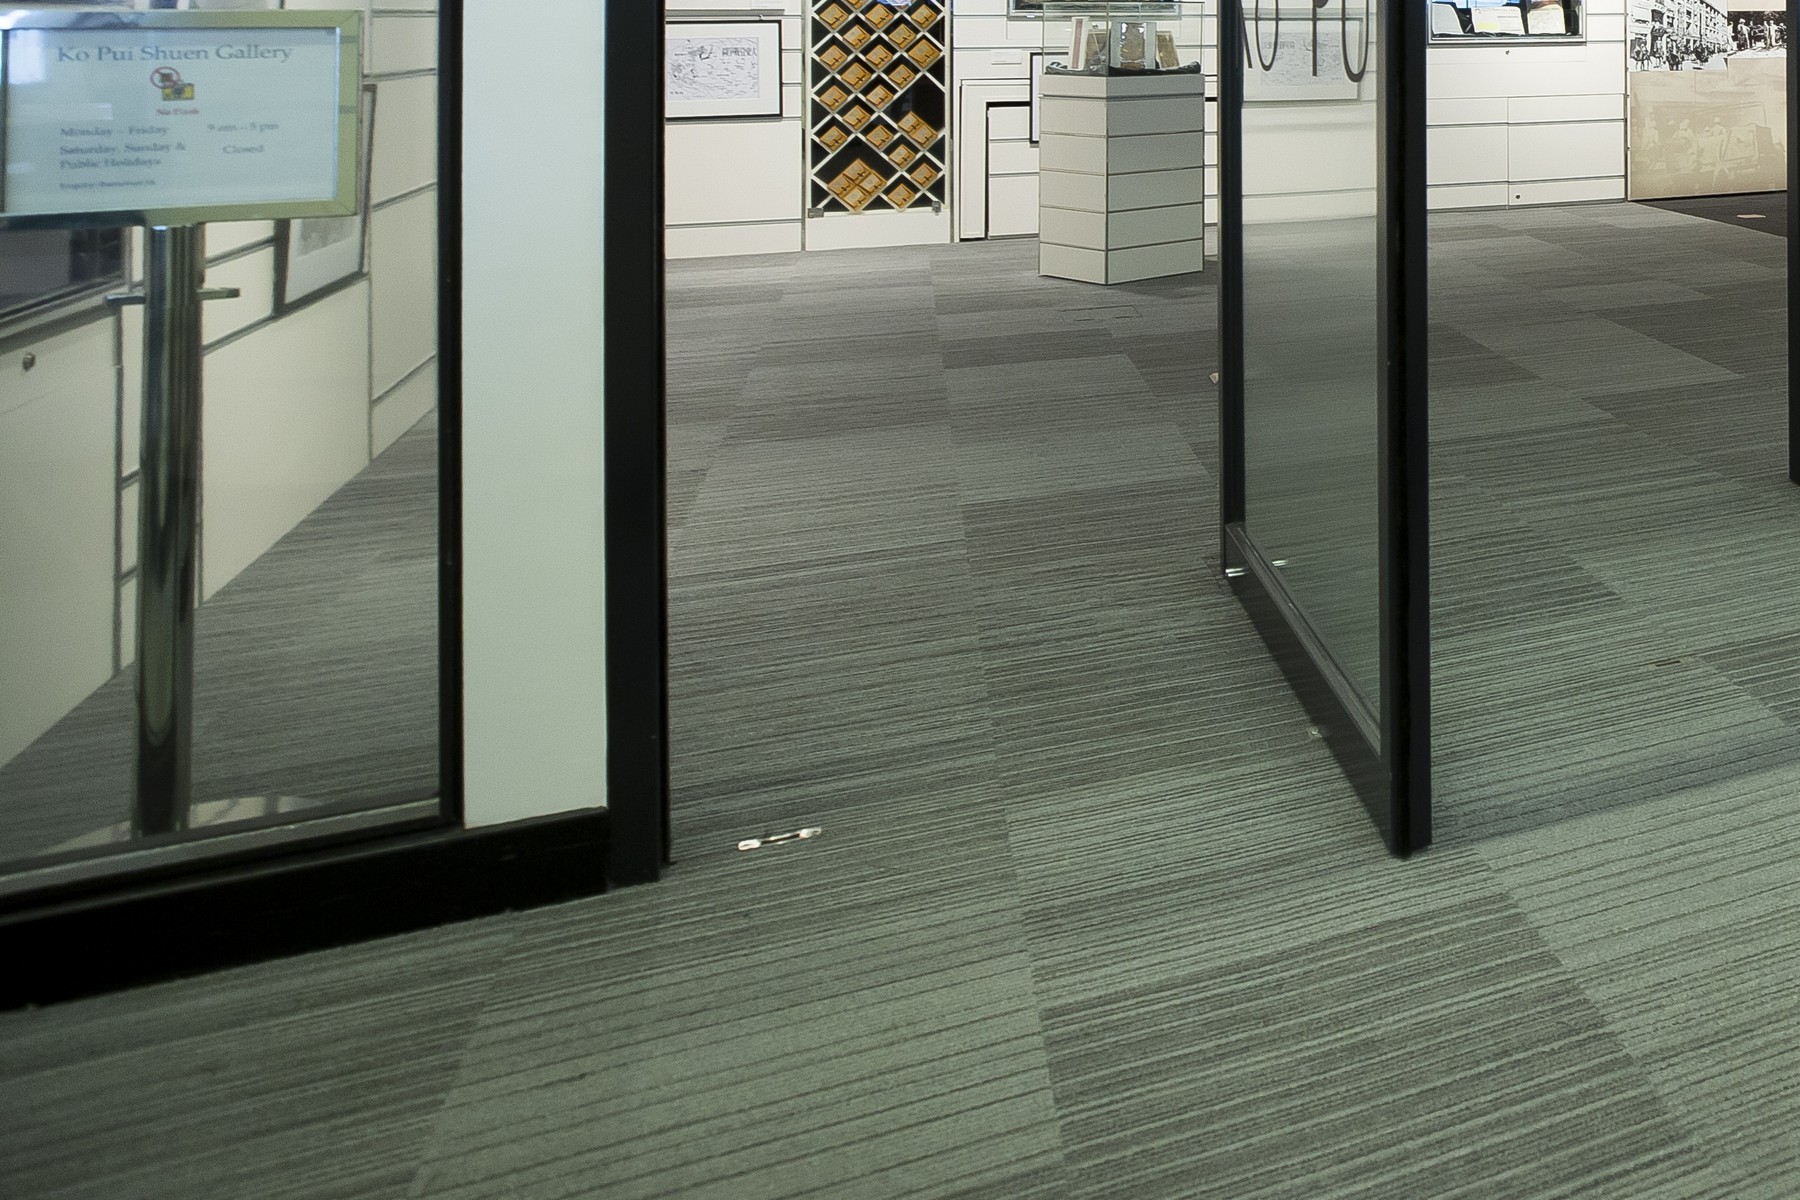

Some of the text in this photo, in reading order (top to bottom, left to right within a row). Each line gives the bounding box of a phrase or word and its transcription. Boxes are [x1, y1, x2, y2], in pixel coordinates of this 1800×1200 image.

[57, 44, 293, 63] Ko Pui Shuen Gallery
